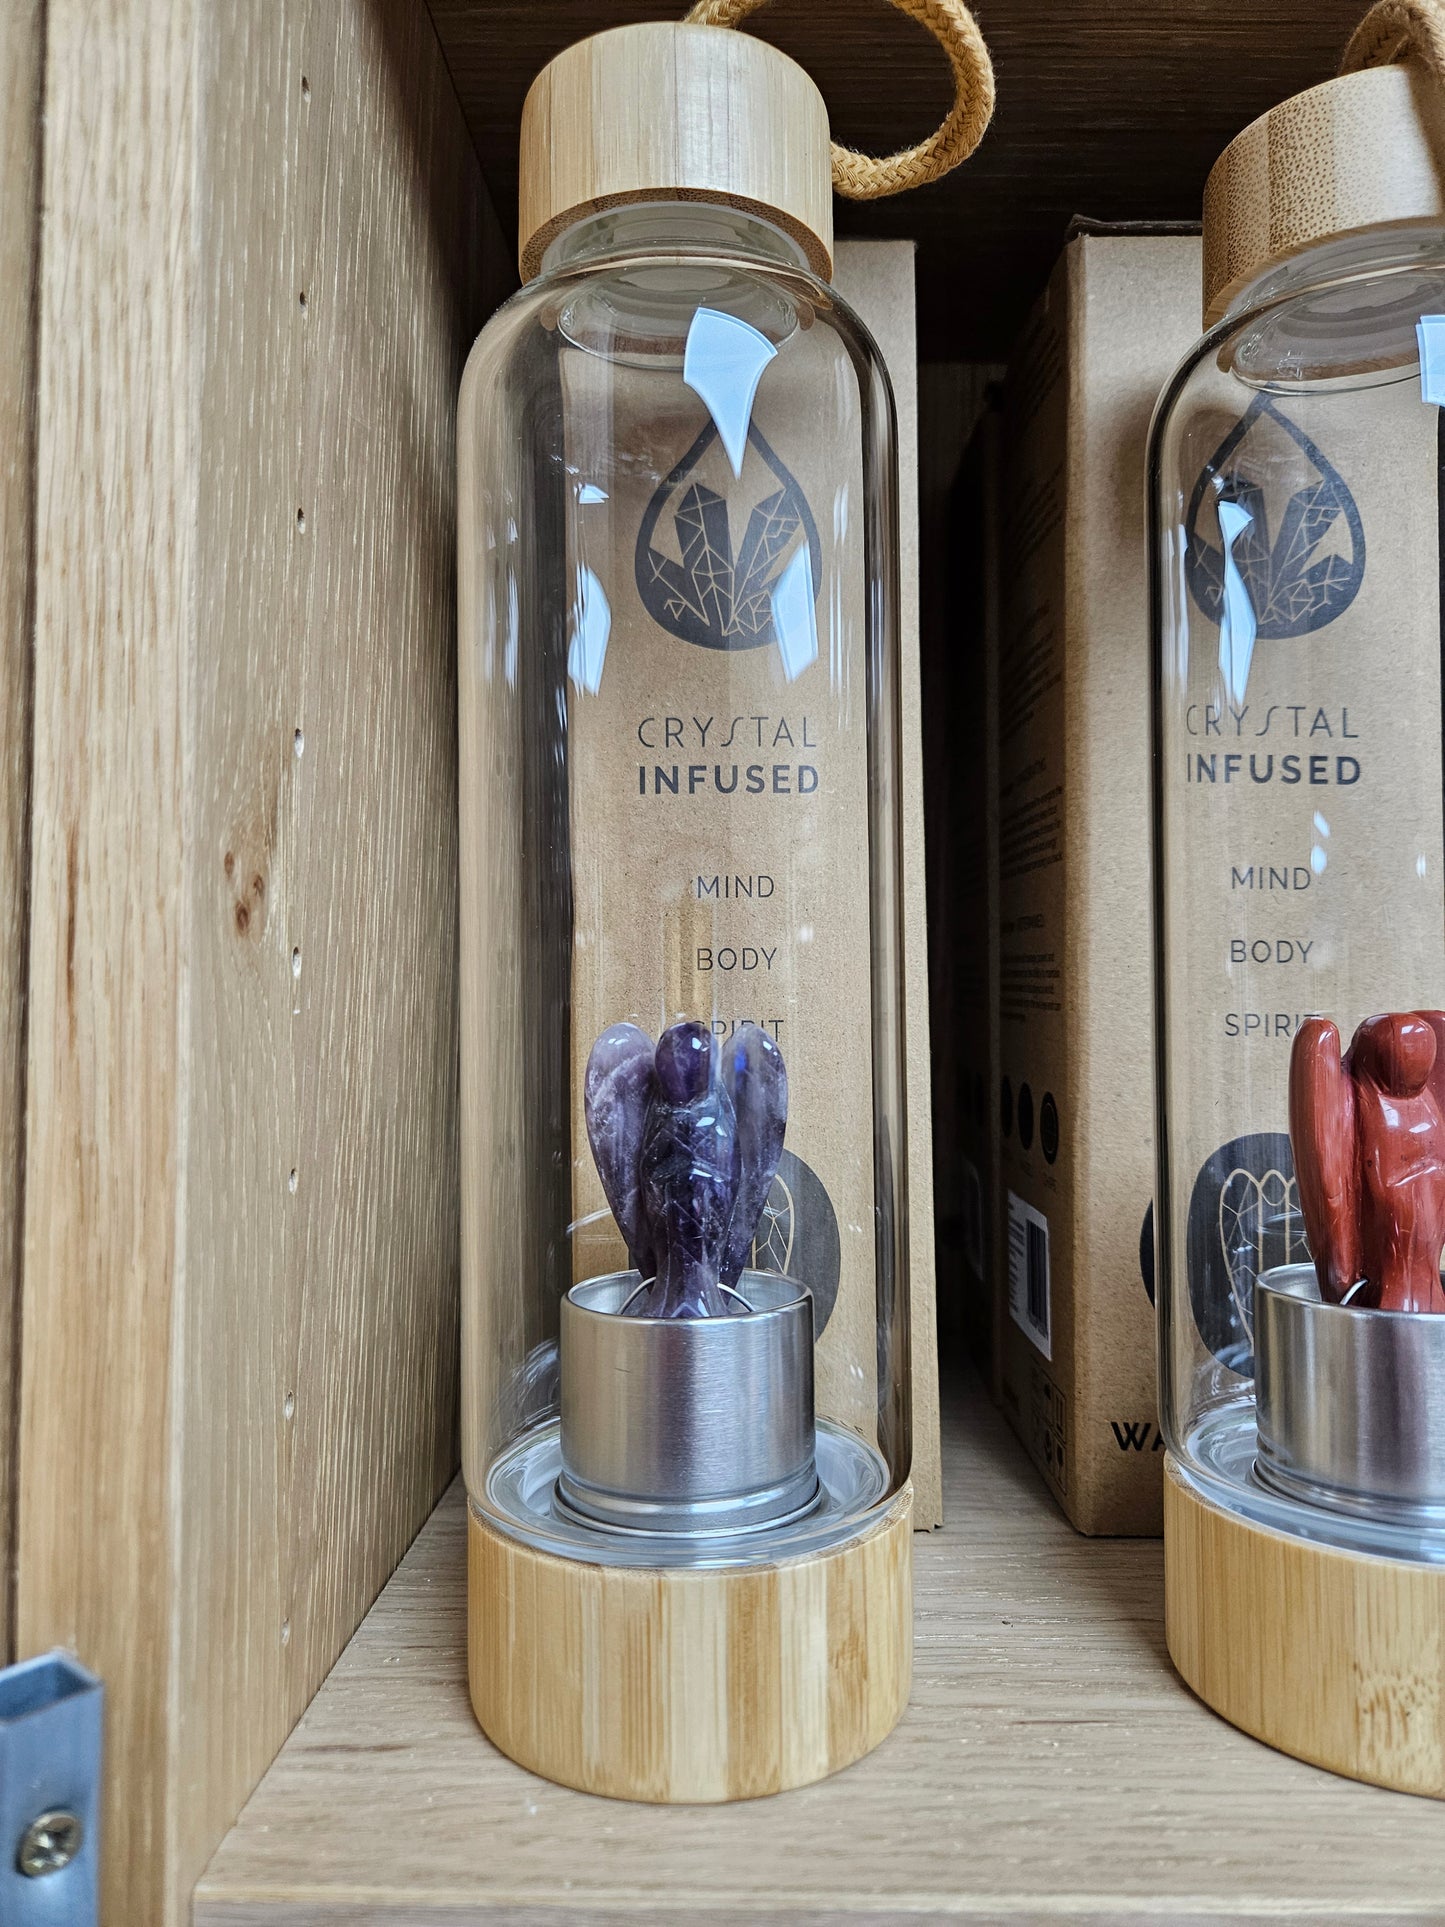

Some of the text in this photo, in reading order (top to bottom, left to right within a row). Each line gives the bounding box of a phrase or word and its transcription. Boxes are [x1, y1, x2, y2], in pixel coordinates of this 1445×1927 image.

[637, 716, 817, 748] CRYSTAL
[1186, 704, 1359, 739] CRYSTAL
[639, 764, 819, 795] INFUSED
[1186, 753, 1361, 785] INFUSED
[696, 875, 775, 899] MIND
[1230, 866, 1312, 891] MIND
[696, 947, 778, 971] BODY
[1230, 939, 1314, 964] BODY
[1224, 1013, 1320, 1037] SPIRI
